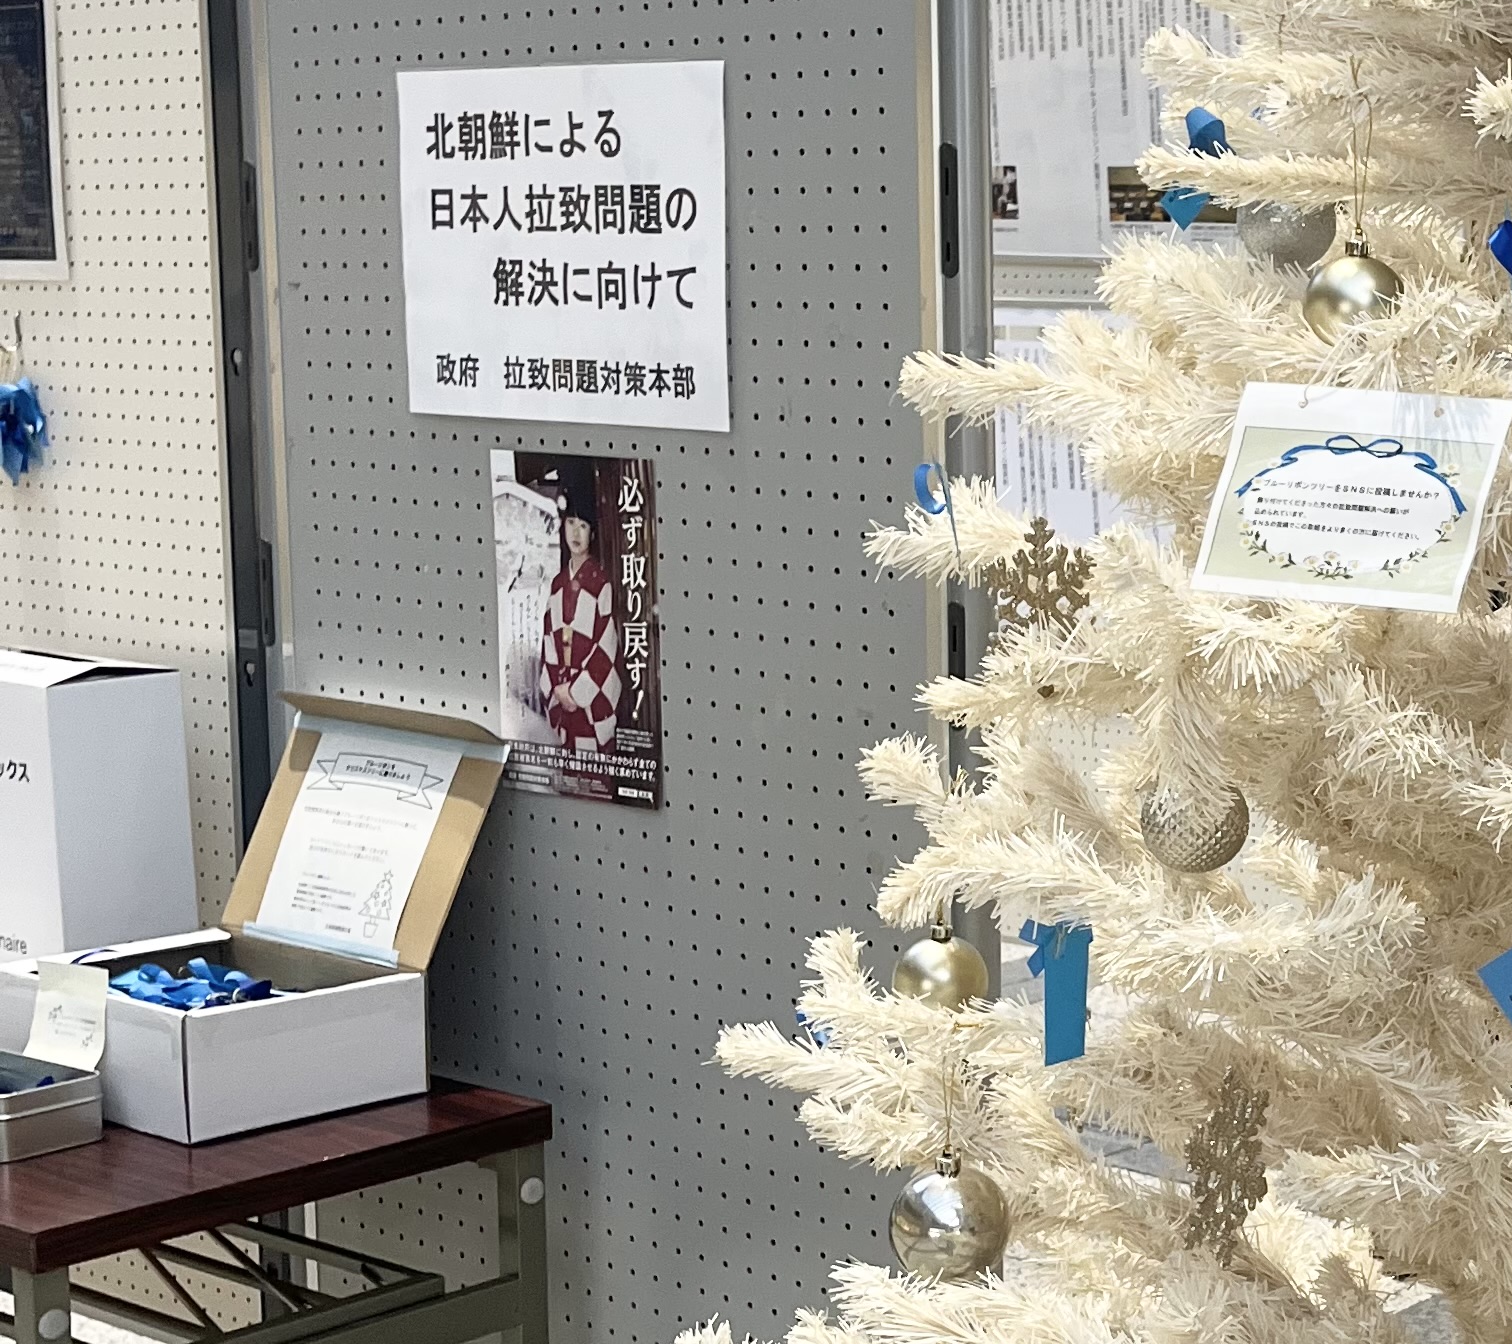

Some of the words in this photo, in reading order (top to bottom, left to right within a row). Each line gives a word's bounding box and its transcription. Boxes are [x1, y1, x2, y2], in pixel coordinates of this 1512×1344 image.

[425, 109, 622, 161] 北朝鮮による
[430, 183, 698, 235] 日本人拉致問題の
[492, 257, 698, 310] 解決に向けて
[436, 353, 480, 388] 政府
[503, 355, 697, 401] 拉致問題対策本部
[617, 476, 650, 721] 必ず取り戻す！
